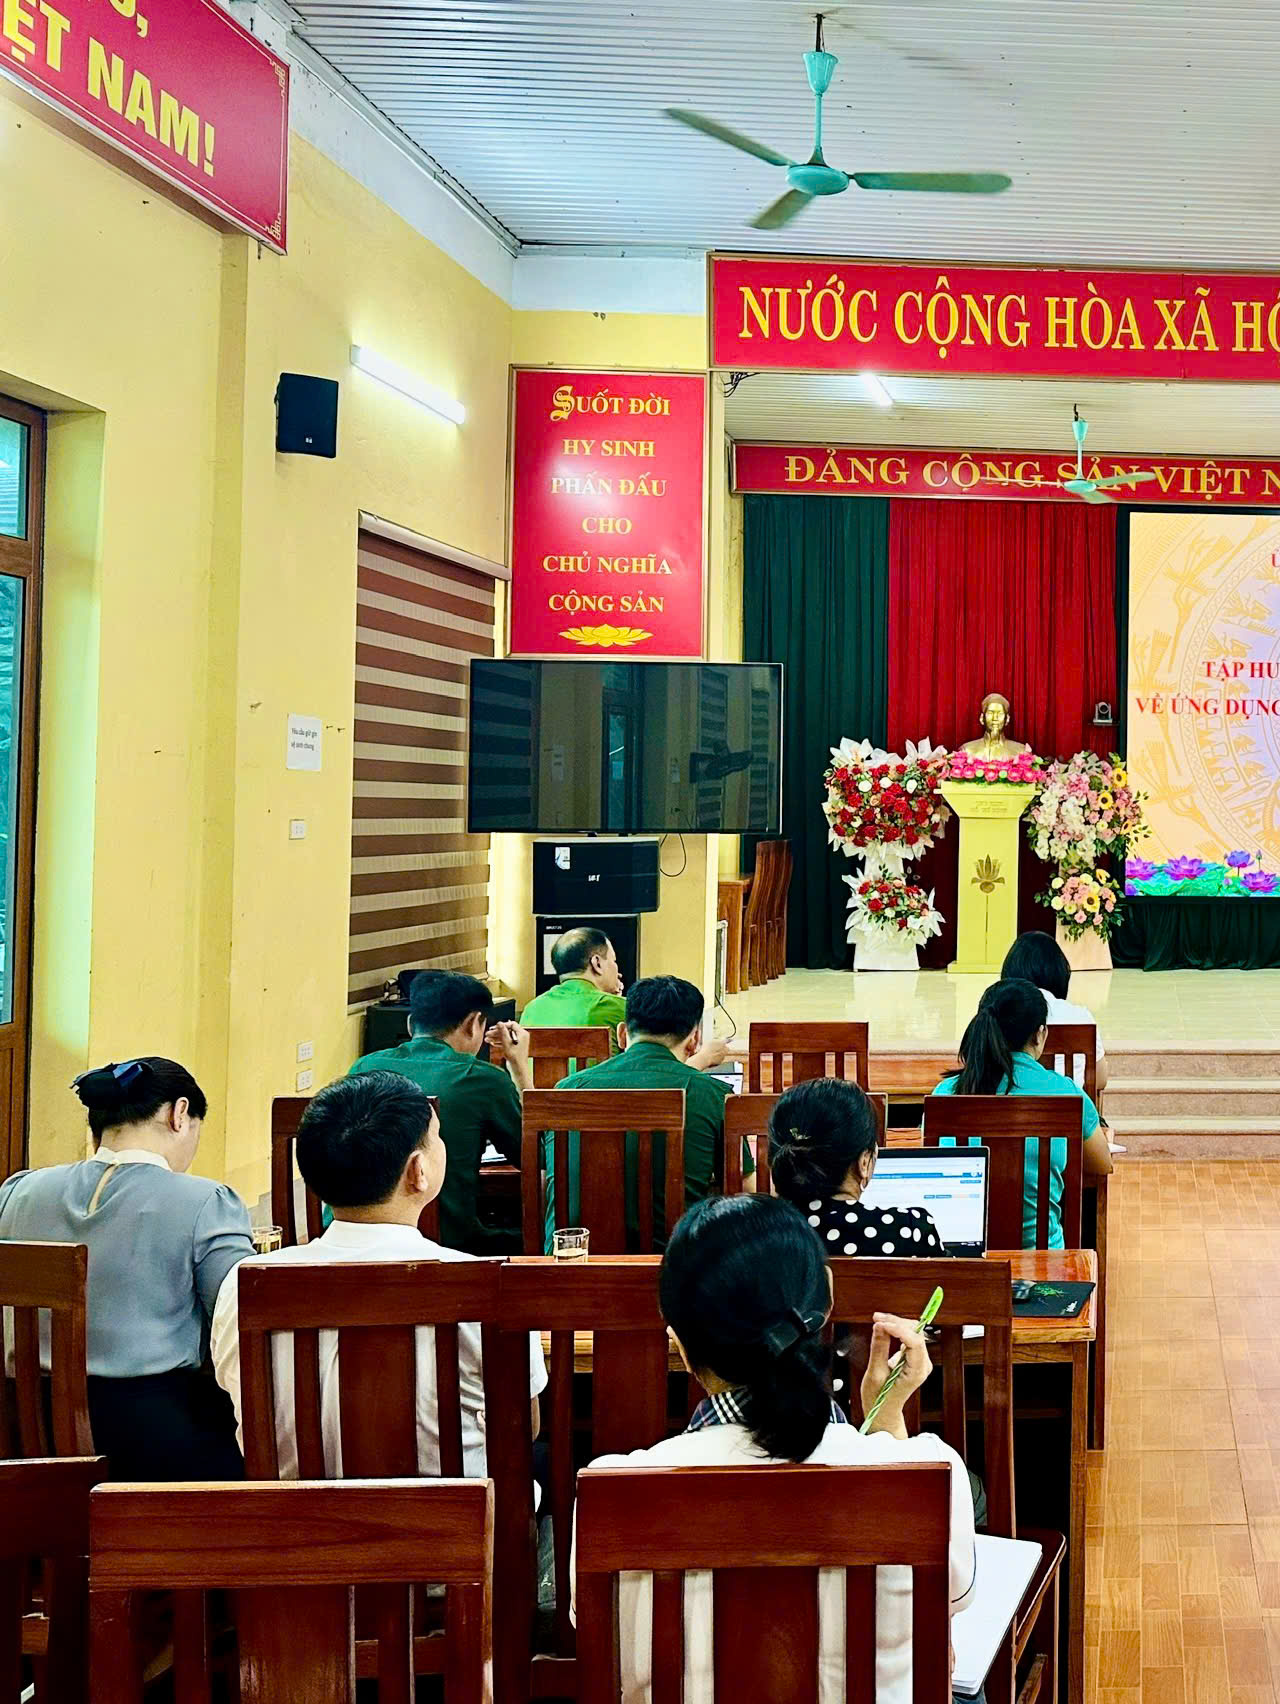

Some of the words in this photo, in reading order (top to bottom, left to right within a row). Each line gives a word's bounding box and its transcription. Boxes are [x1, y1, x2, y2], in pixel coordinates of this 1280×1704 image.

[0, 0, 71, 72] ỆT
[87, 36, 215, 177] NAM!
[739, 274, 877, 342] NƯỚC
[894, 275, 1030, 358] CỘNG
[1044, 281, 1144, 350] HÒA
[1154, 287, 1219, 351] XÃ
[549, 385, 623, 421] SUỐT
[628, 392, 671, 416] ĐỜI
[562, 439, 595, 457] HY
[600, 440, 656, 457] SINH
[551, 471, 612, 494] PHẤN
[618, 472, 667, 496] ĐẤU
[785, 448, 910, 484] ĐẢNG
[923, 453, 1043, 492] CỘNG
[1057, 457, 1140, 491] SẢN
[1152, 461, 1251, 504] VIỆT
[581, 516, 633, 535] CHO
[542, 551, 592, 573] CHỦ
[596, 552, 673, 575] NGHĨA
[548, 589, 615, 616] CỘNG
[619, 590, 665, 613] SẢN
[1202, 659, 1244, 682] TẬP
[1170, 692, 1219, 715] ỨNG
